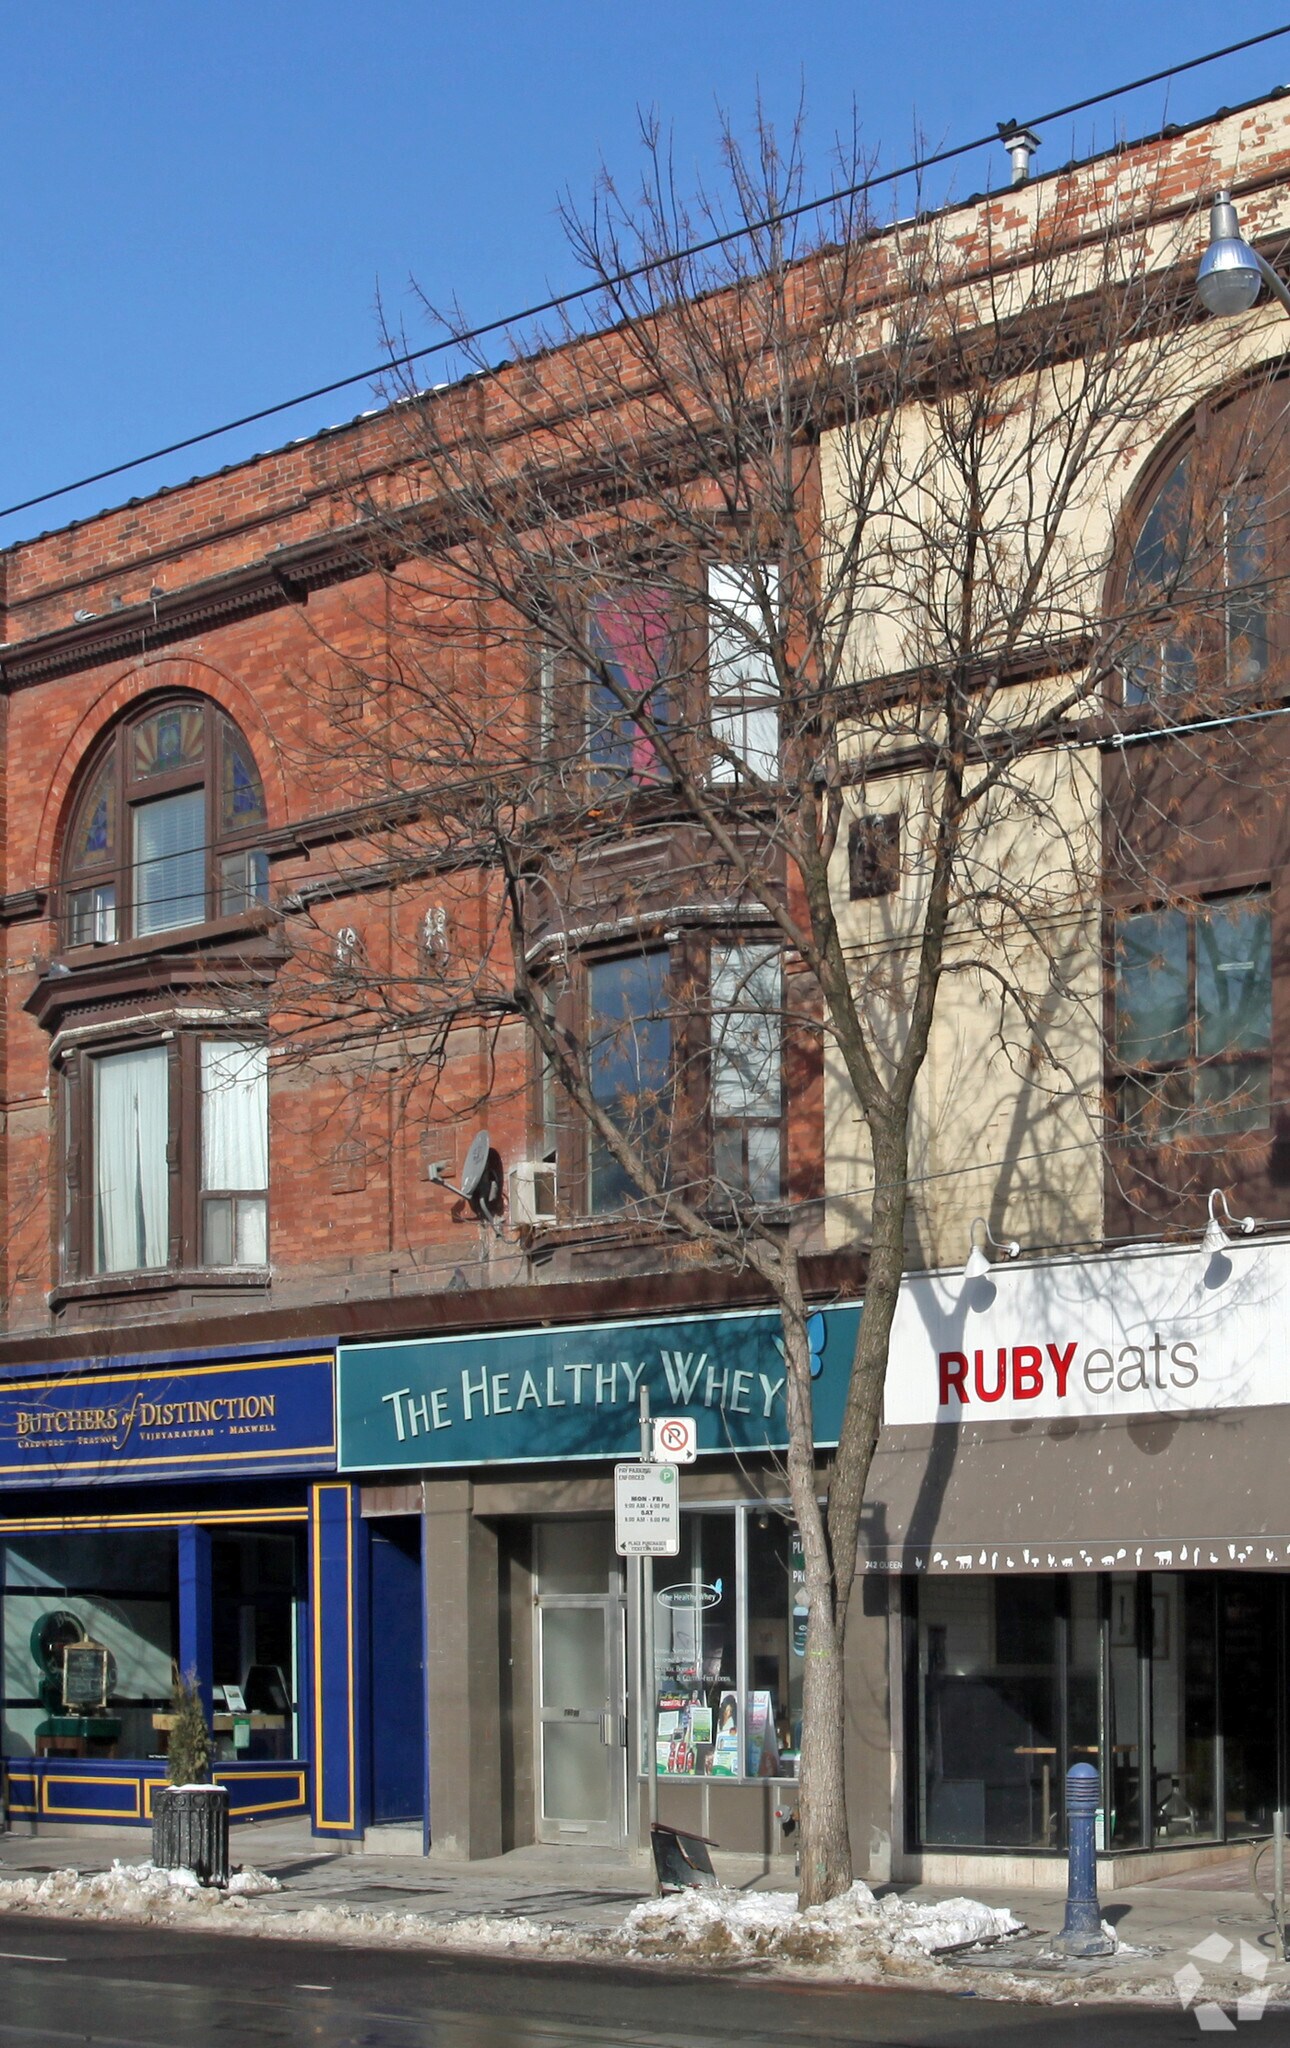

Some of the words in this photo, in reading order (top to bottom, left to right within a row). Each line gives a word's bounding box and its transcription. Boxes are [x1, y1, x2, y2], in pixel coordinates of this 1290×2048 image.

[382, 1387, 452, 1441] THE
[461, 1361, 646, 1420] HEALTHY
[660, 1350, 786, 1418] WHEY
[16, 1408, 118, 1434] BUTCHERS
[121, 1392, 144, 1450] of
[139, 1394, 276, 1427] DISTINCTION
[229, 1424, 277, 1435] MAXWELL
[865, 1560, 878, 1569] 742
[879, 1560, 903, 1569] QUEEN
